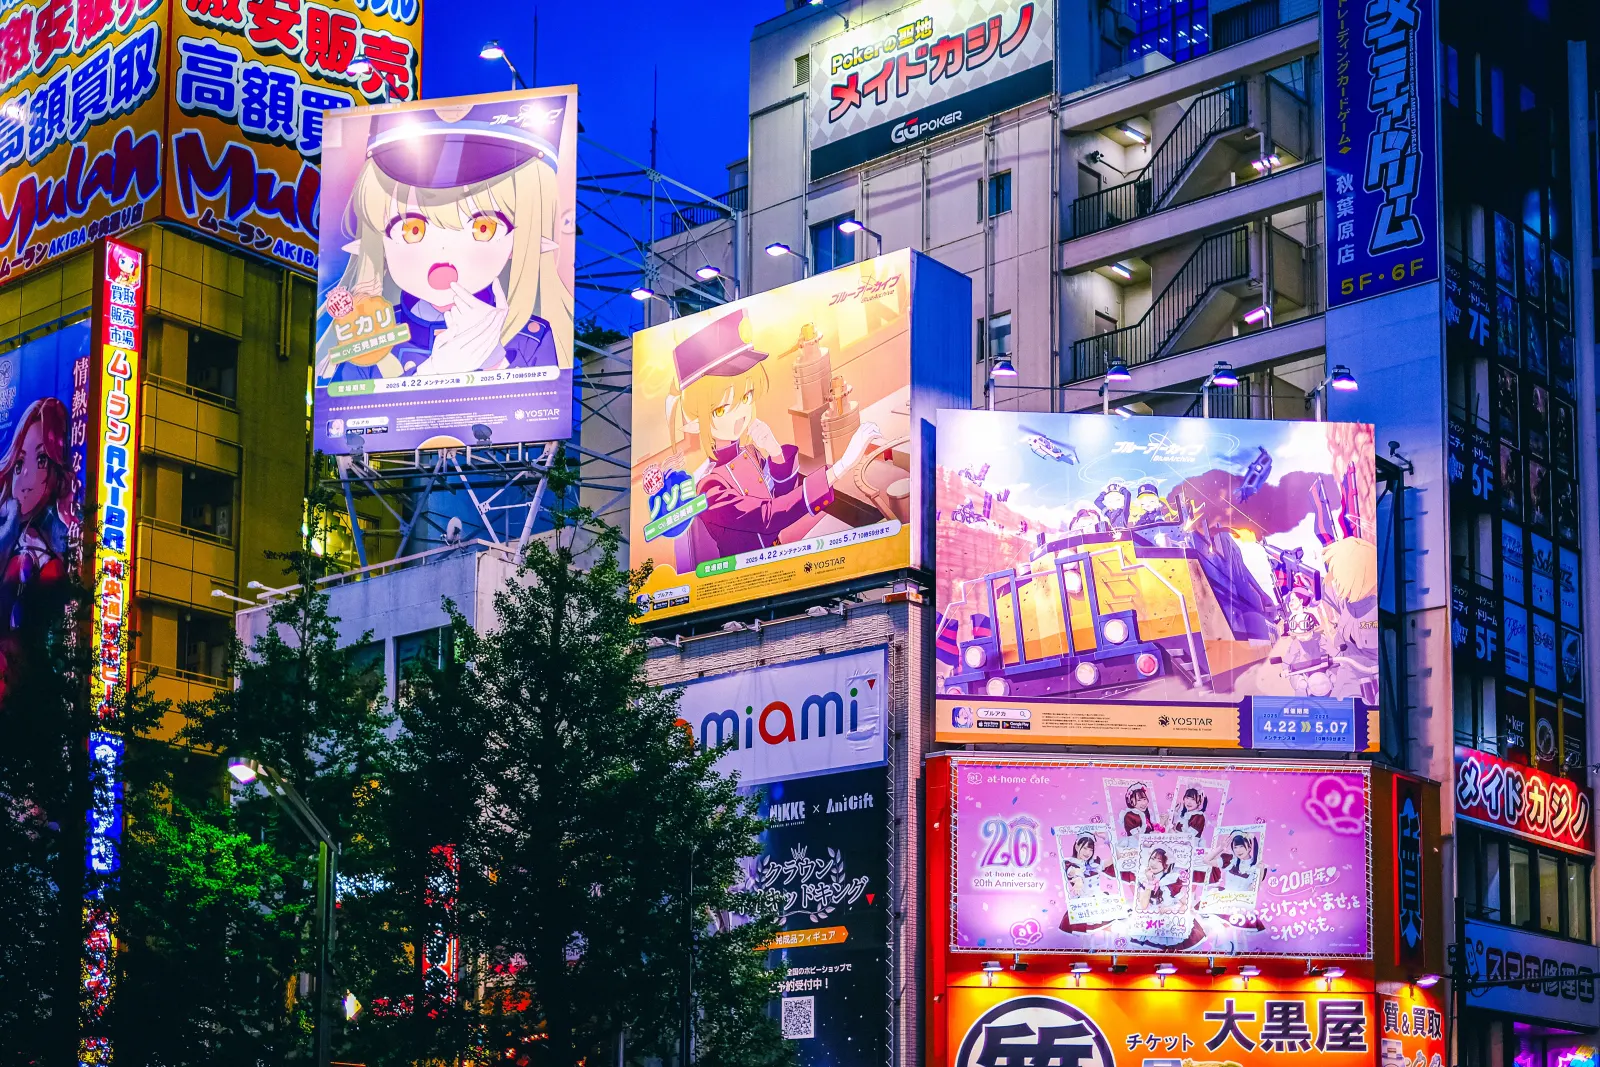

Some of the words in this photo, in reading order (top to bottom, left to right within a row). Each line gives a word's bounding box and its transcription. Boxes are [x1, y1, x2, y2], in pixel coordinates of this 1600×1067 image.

[831, 16, 934, 75] Pokerの聖地
[828, 2, 1034, 123] メイドカジノ
[1336, 173, 1355, 266] 秋葉原店
[272, 238, 319, 270] AKIB
[111, 284, 135, 305] 買取
[110, 306, 135, 326] 販売
[335, 307, 392, 341] ヒカリ
[1468, 308, 1490, 346] 7F
[110, 327, 135, 348] 市場
[401, 380, 422, 388] 4.22
[525, 408, 560, 418] YOSTAR
[650, 479, 696, 521] ノゾミ
[759, 550, 777, 560] 4.22
[813, 556, 846, 570] YOSTAR
[1475, 624, 1497, 662] 5F
[1171, 717, 1213, 726] YOSTAR
[1264, 720, 1296, 732] 4.22
[1315, 722, 1348, 733] 5.07
[987, 775, 1026, 784] at-home
[1029, 775, 1050, 784] cafe
[769, 800, 806, 822] NIKKE
[825, 792, 874, 814] AniGift
[1459, 760, 1588, 839] メイドカジノ
[980, 818, 1038, 868] 20
[766, 857, 834, 886] クラウン
[973, 879, 993, 888] 20th
[995, 879, 1045, 890] Anniversary
[1270, 916, 1335, 942] これからも。
[786, 963, 852, 976] 全国のホビーショップで
[1203, 997, 1369, 1054] 大黒屋
[1126, 1033, 1195, 1052] チケット
